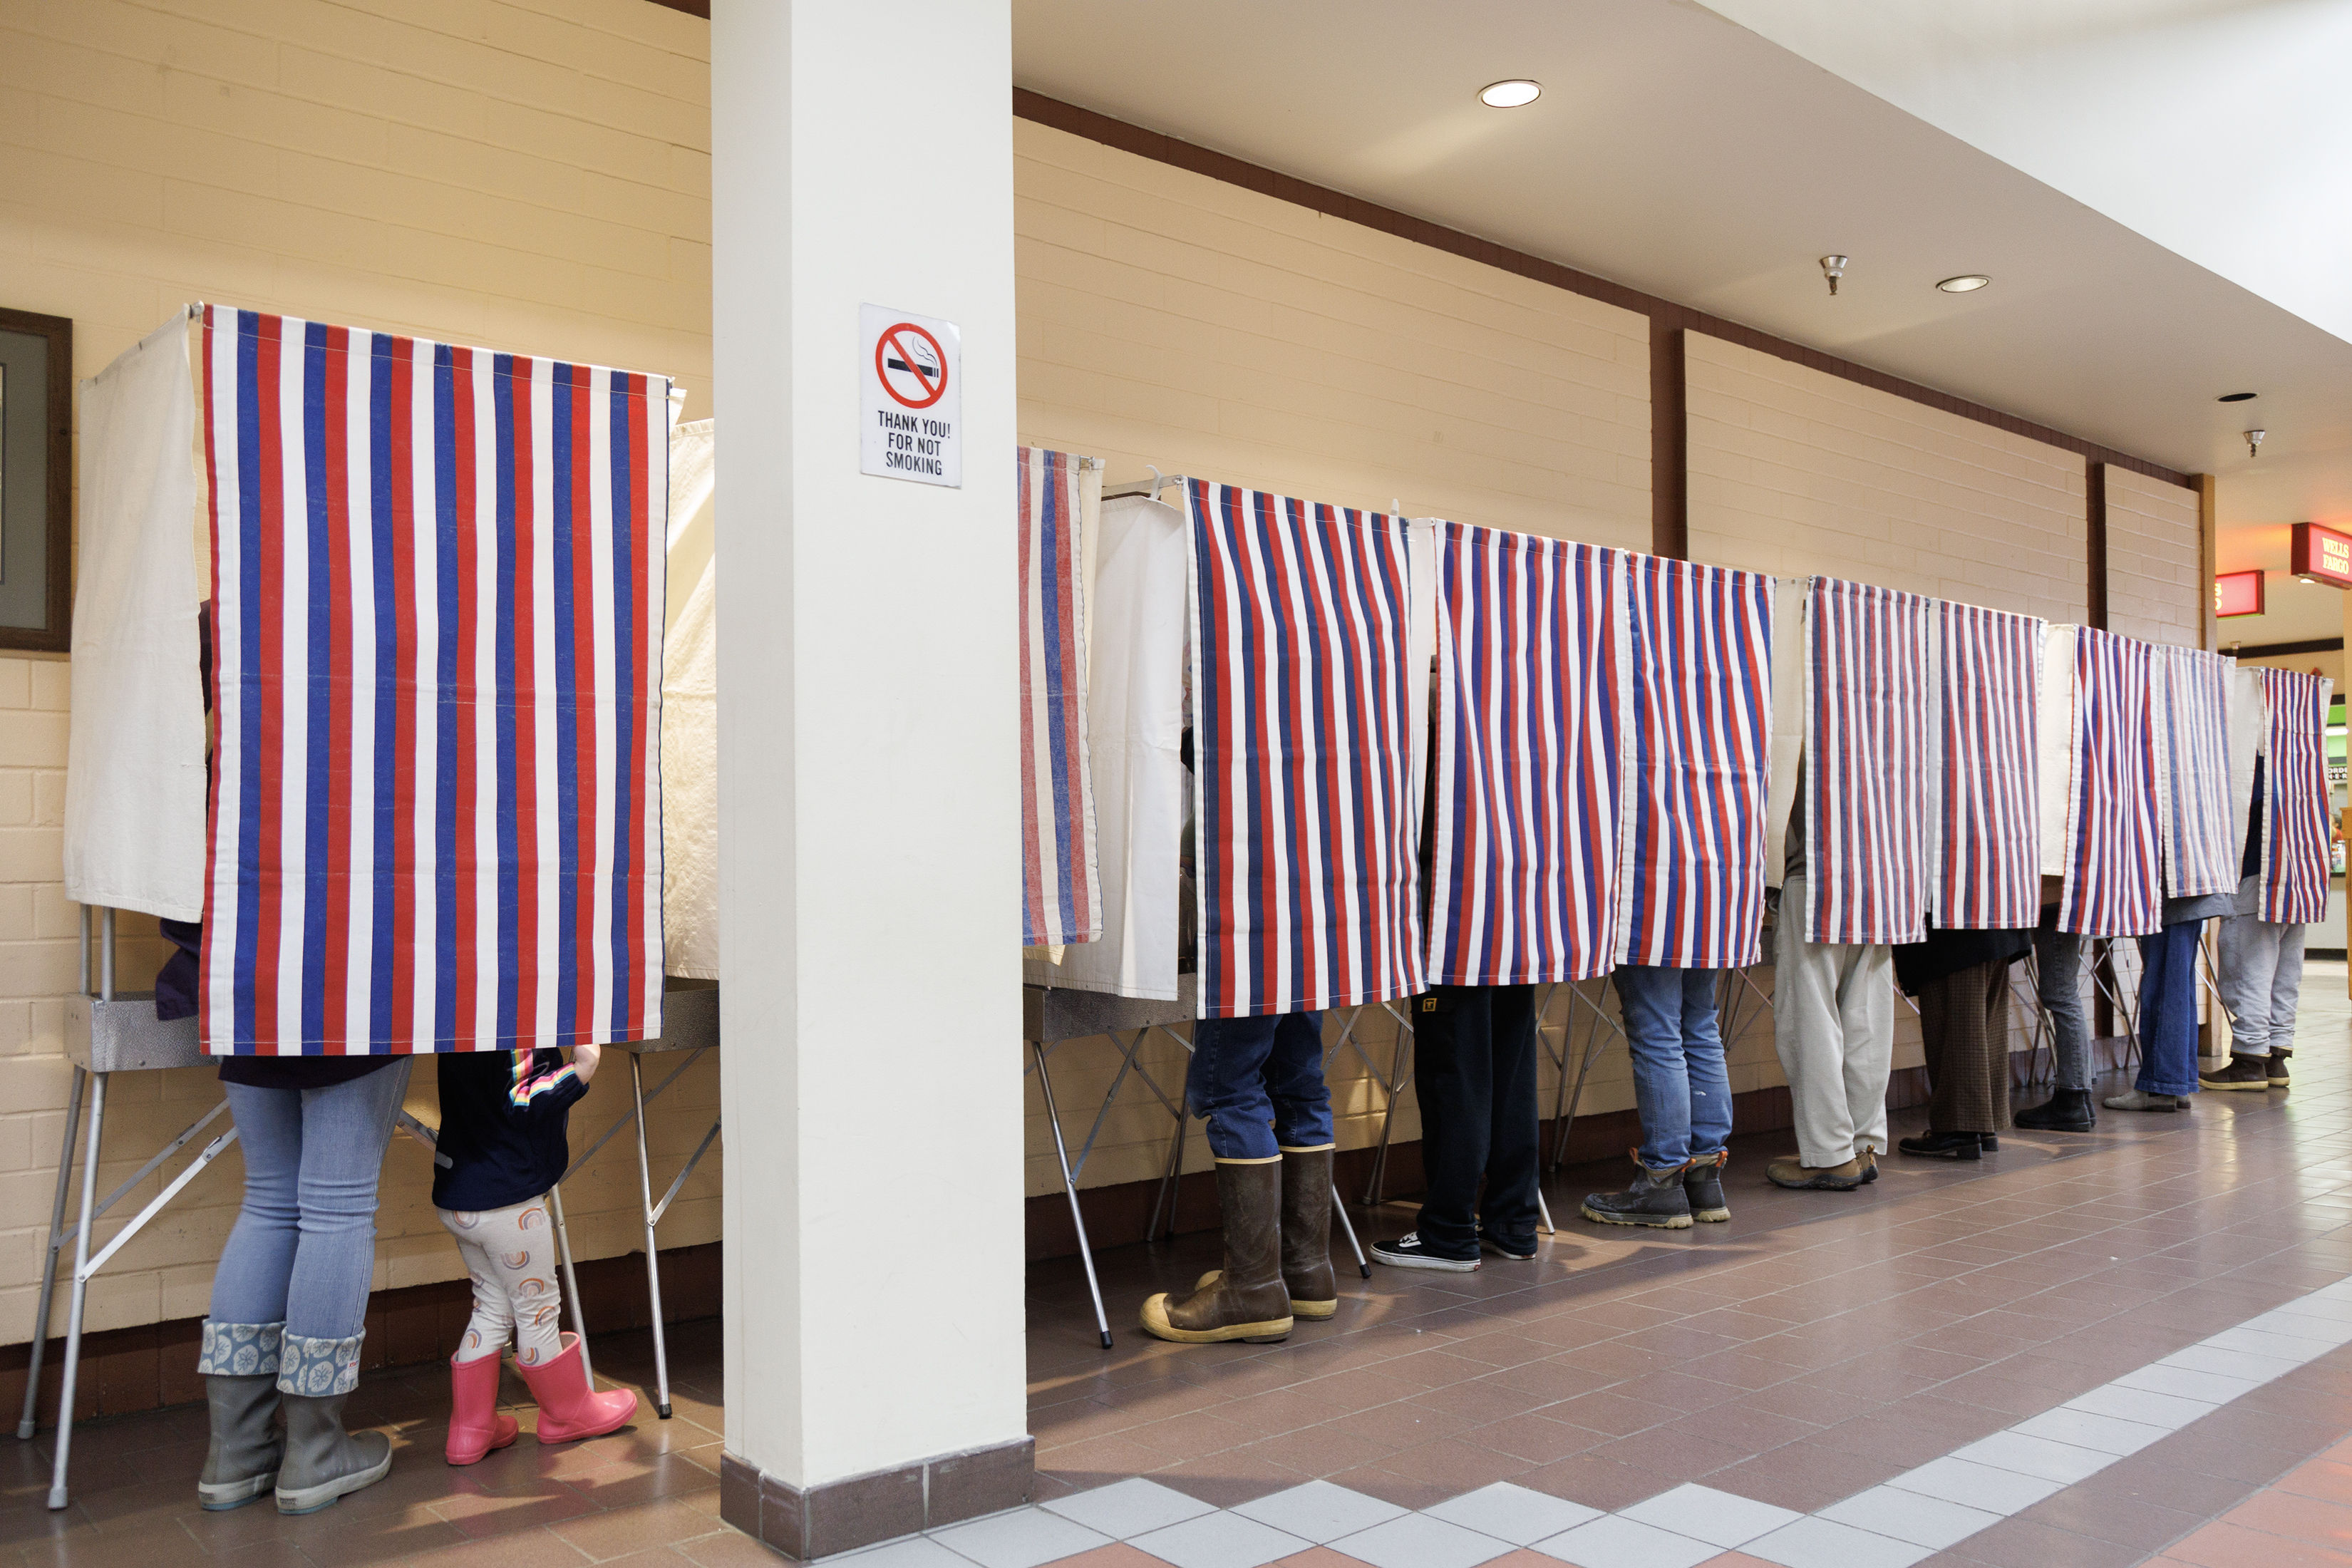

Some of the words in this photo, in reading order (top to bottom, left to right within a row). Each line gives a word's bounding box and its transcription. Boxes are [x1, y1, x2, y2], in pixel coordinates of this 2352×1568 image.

[877, 410, 918, 433] THANK
[922, 418, 951, 438] YOU!
[888, 432, 912, 452] FOR
[917, 437, 942, 456] NOT
[886, 451, 942, 476] SMOKING
[2321, 537, 2349, 559] WELLS
[2322, 554, 2349, 574] FARGO
